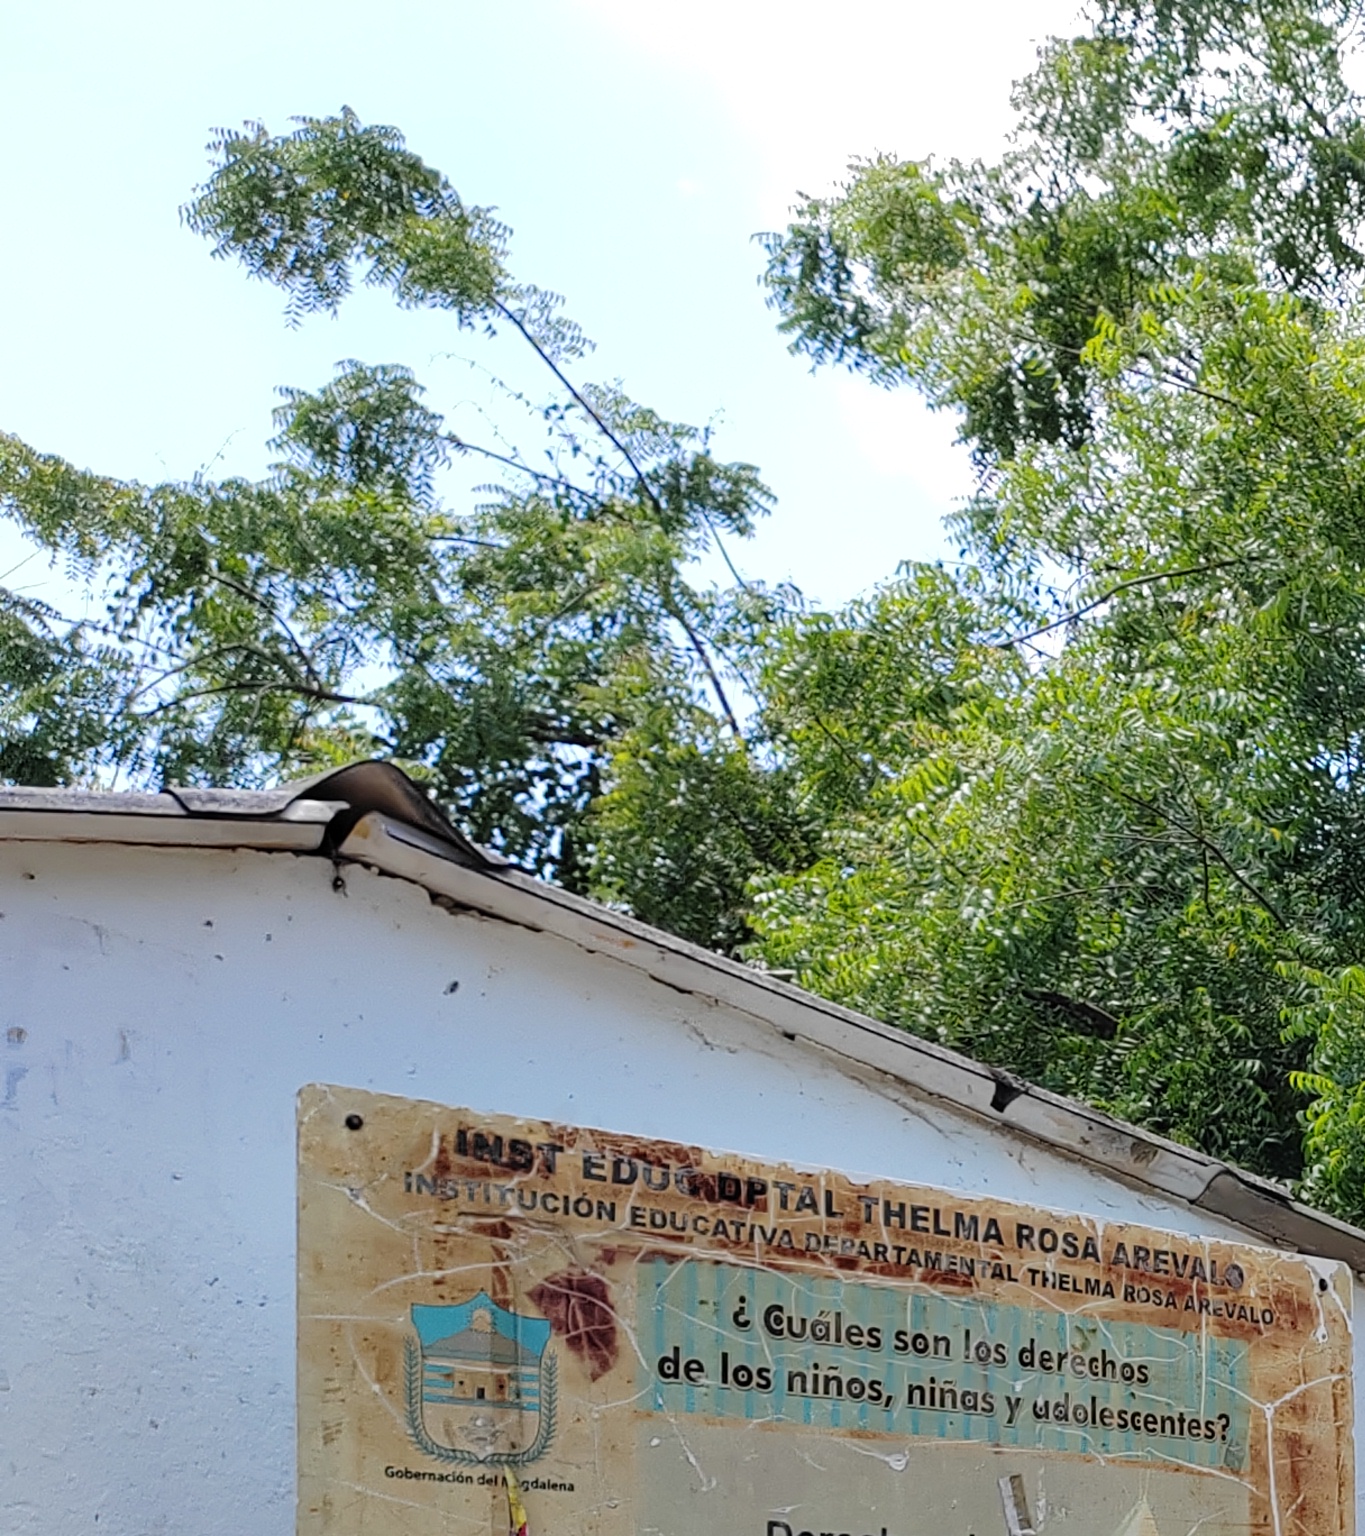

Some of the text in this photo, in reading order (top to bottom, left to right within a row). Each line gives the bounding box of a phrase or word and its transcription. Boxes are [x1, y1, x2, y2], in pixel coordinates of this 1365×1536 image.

[404, 1171, 1275, 1326] INSTITUCIÓN EDUCATIVA DEPARTAMENTAL THELMA ROSA AREVALO
[456, 1129, 564, 1174] INST
[718, 1171, 844, 1219] DPTAL
[857, 1195, 1004, 1247] THELMA
[1015, 1222, 1101, 1263] ROSA
[1111, 1241, 1246, 1290] AREVALO
[657, 1346, 1231, 1441] de los niños, niñas y adolescentes?
[893, 1329, 951, 1357] son
[964, 1329, 1007, 1364] los
[1018, 1338, 1149, 1384] derechos
[385, 1465, 575, 1493] Gobernación del Mgdalena
